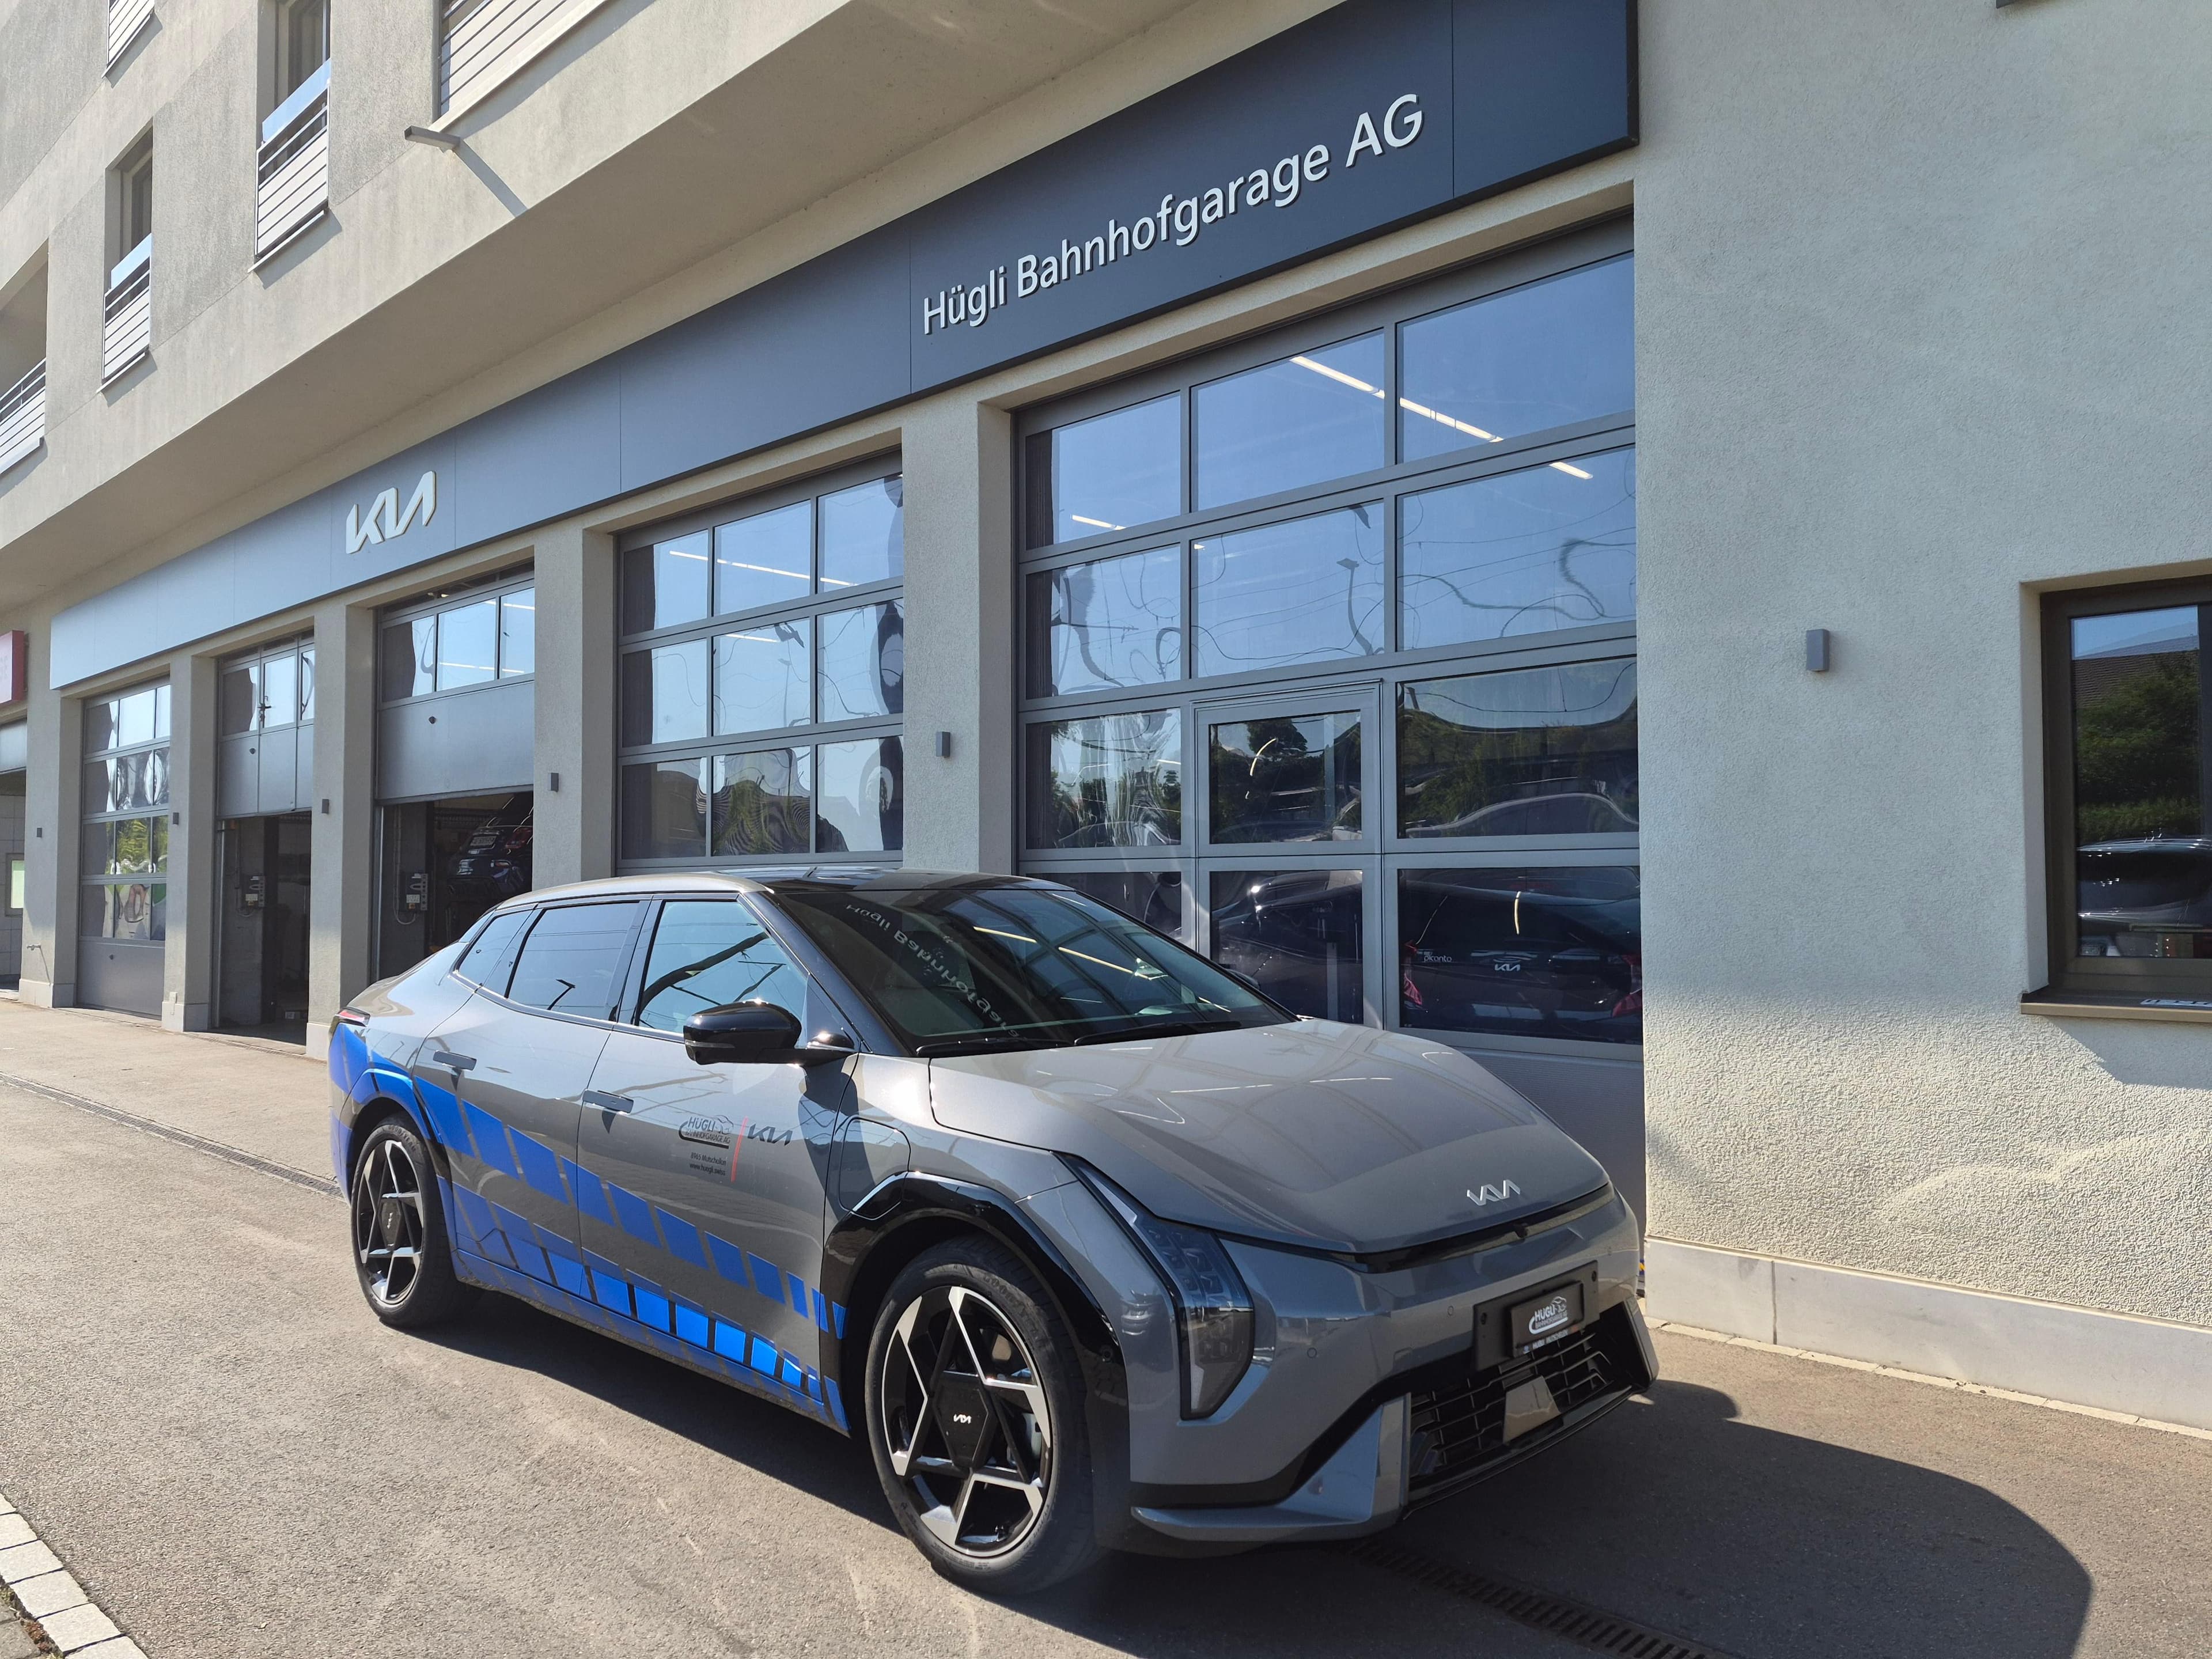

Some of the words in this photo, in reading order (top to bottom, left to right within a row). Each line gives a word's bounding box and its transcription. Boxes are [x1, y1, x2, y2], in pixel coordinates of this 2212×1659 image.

[923, 266, 1007, 334] Hügli
[1017, 143, 1330, 298] Bahnhofgarage
[1345, 93, 1423, 166] AG
[346, 470, 436, 555] KIA
[1494, 964, 1521, 972] KIA
[688, 1116, 715, 1132] HÜGLI
[747, 1123, 793, 1146] KIA
[1467, 1179, 1521, 1206] KIA
